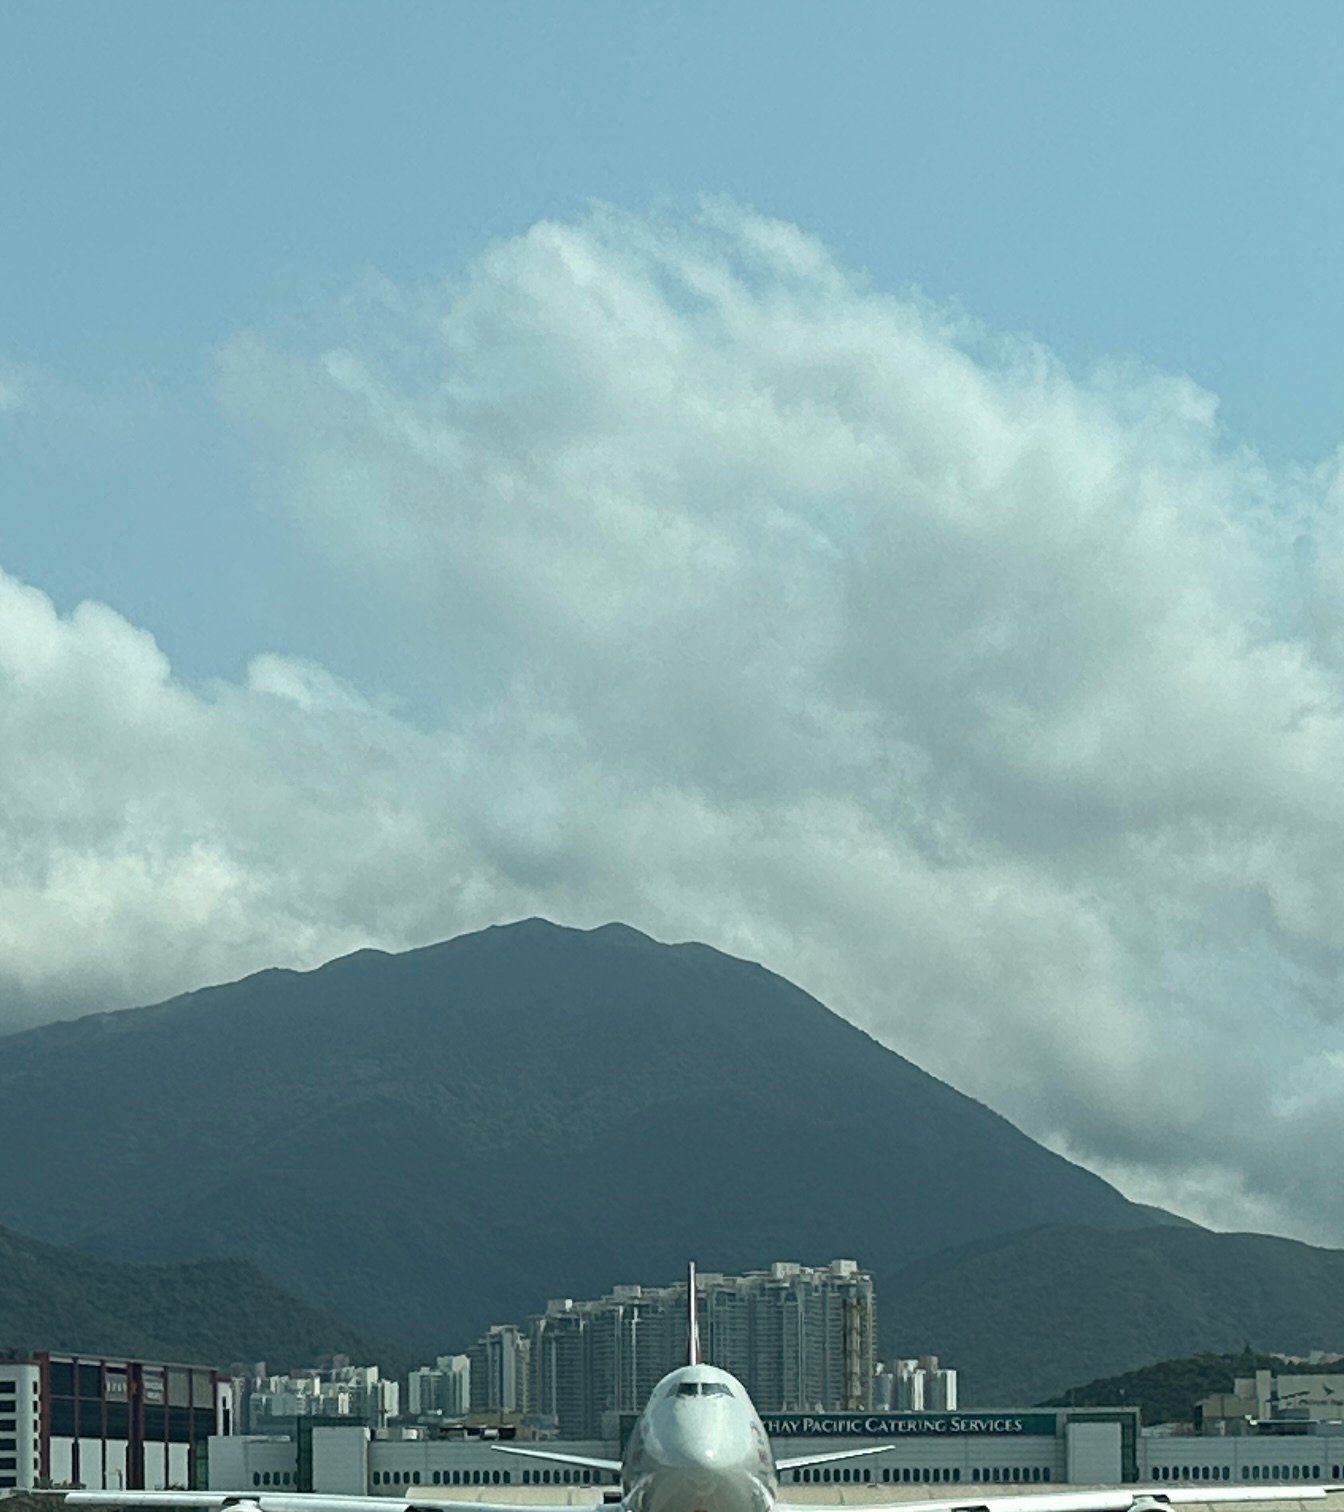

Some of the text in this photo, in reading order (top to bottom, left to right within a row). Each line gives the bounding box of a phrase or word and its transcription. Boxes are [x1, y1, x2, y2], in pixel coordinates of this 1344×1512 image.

[762, 1420, 798, 1433] HAY
[865, 1417, 946, 1433] CATERING
[950, 1417, 1022, 1432] SERVICES
